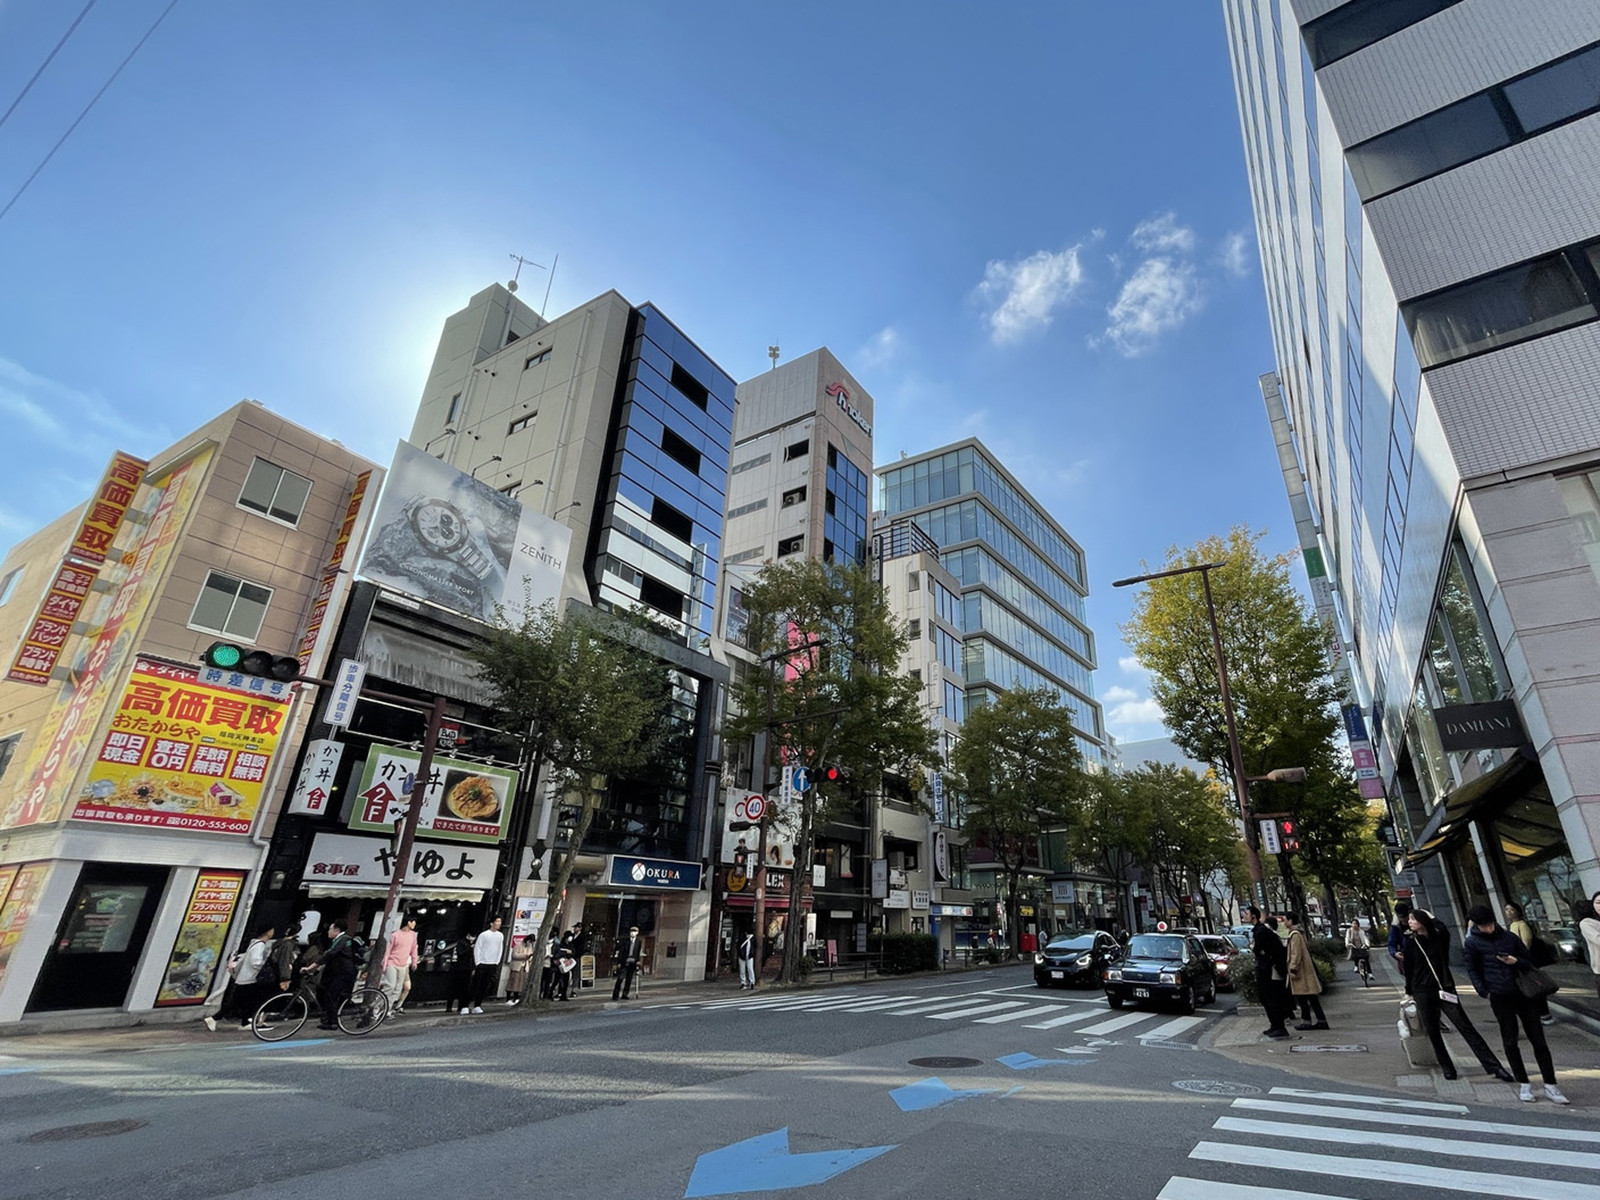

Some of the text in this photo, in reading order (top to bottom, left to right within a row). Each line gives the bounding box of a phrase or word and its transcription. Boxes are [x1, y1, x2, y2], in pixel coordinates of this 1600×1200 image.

[77, 458, 145, 550] 高価買取
[520, 542, 562, 570] ZENITH
[455, 584, 474, 596] SPORT
[49, 595, 79, 610] ダイヤ
[36, 620, 69, 635] ブランド
[31, 631, 63, 645] バッグ
[24, 646, 57, 660] ブランド
[19, 657, 50, 671] 時計
[205, 668, 284, 695] 時差信号
[334, 664, 358, 721] 歩車分離信号
[121, 681, 284, 736] 高価買取
[112, 713, 201, 740] おたからや
[1446, 716, 1511, 736] DAMIANI
[108, 731, 145, 751] 即日
[156, 738, 190, 756] 査定
[102, 746, 141, 764] 現金
[196, 746, 230, 762] 手数料
[237, 752, 268, 769] 相談
[191, 760, 224, 776] 無料
[231, 765, 263, 781] 無料
[315, 746, 338, 783] かつ丼
[310, 789, 321, 808] 2F
[368, 787, 386, 821] 2F
[749, 801, 761, 814] 40
[180, 817, 249, 831] 0120-555-600
[312, 862, 360, 876] 食事屋
[646, 867, 680, 880] OKURA
